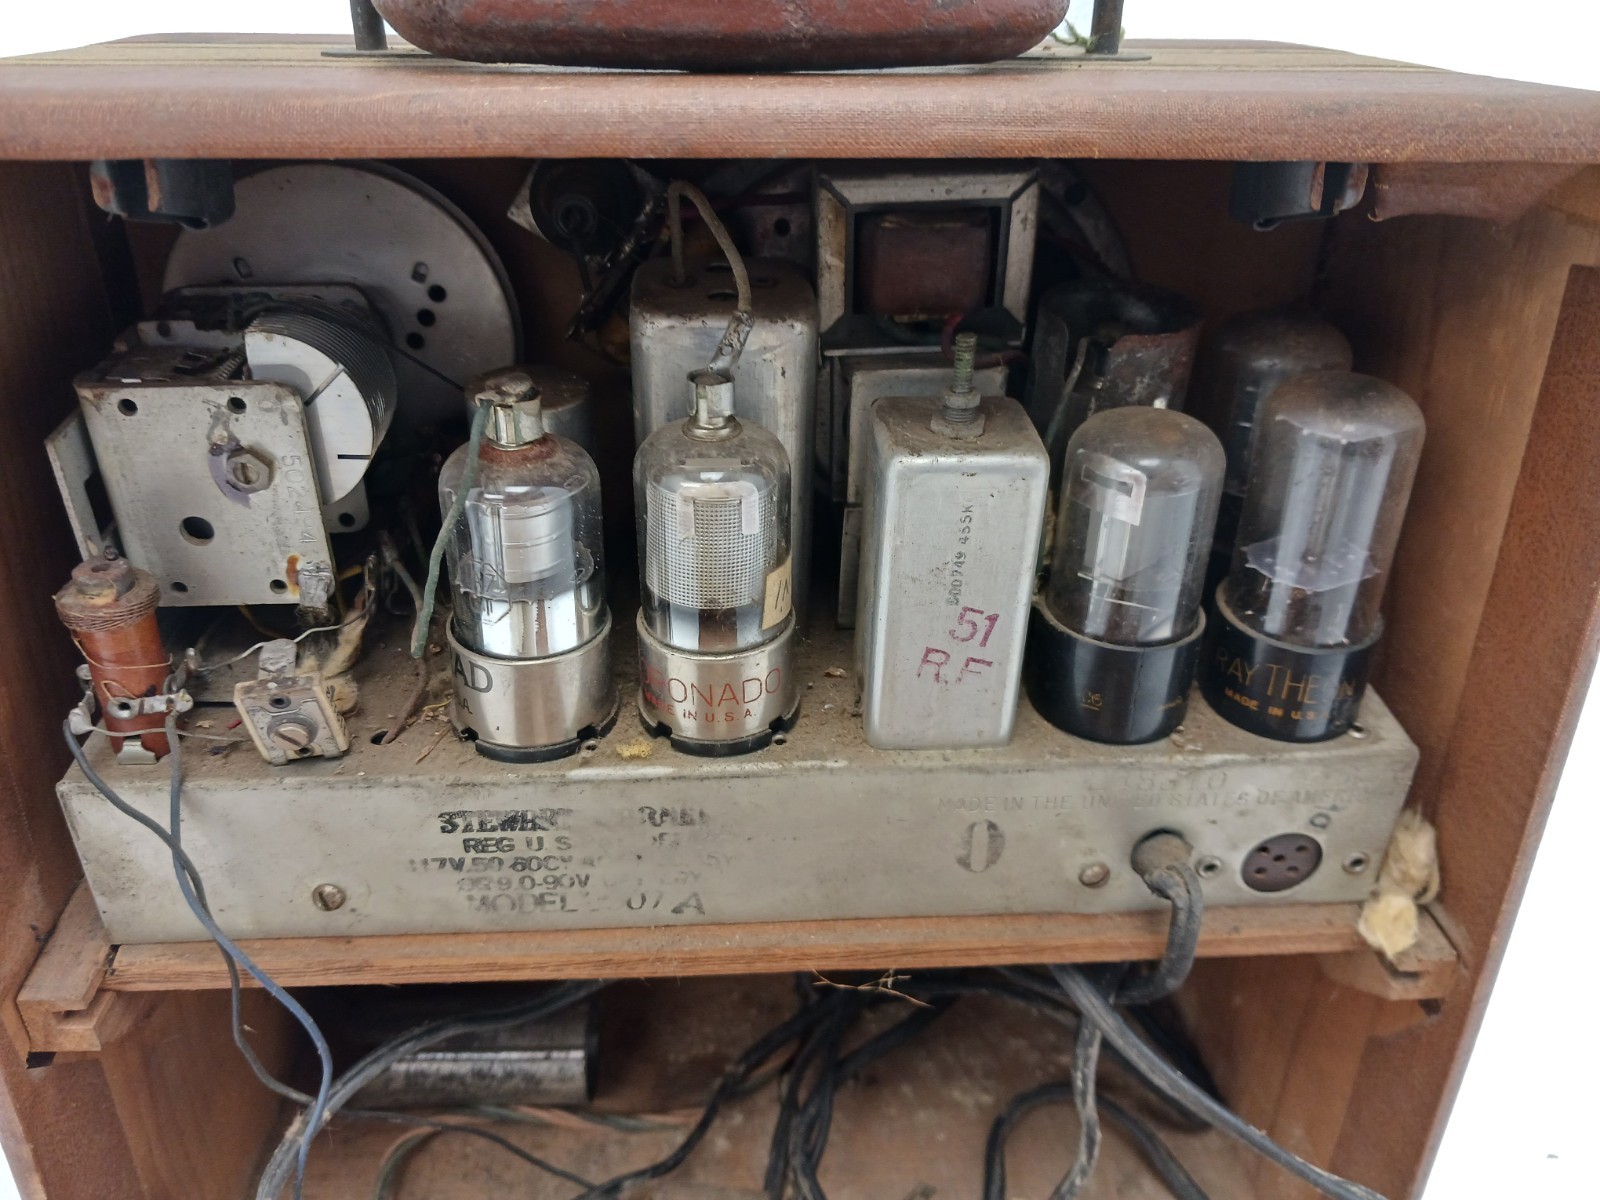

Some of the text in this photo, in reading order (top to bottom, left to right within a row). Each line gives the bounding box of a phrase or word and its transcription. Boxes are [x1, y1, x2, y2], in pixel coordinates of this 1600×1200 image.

[949, 606, 1000, 648] 51
[1216, 647, 1357, 705] RAYTHEN
[1031, 795, 1073, 810] THE
[1082, 792, 1161, 810] UNED
[463, 837, 515, 853] REG
